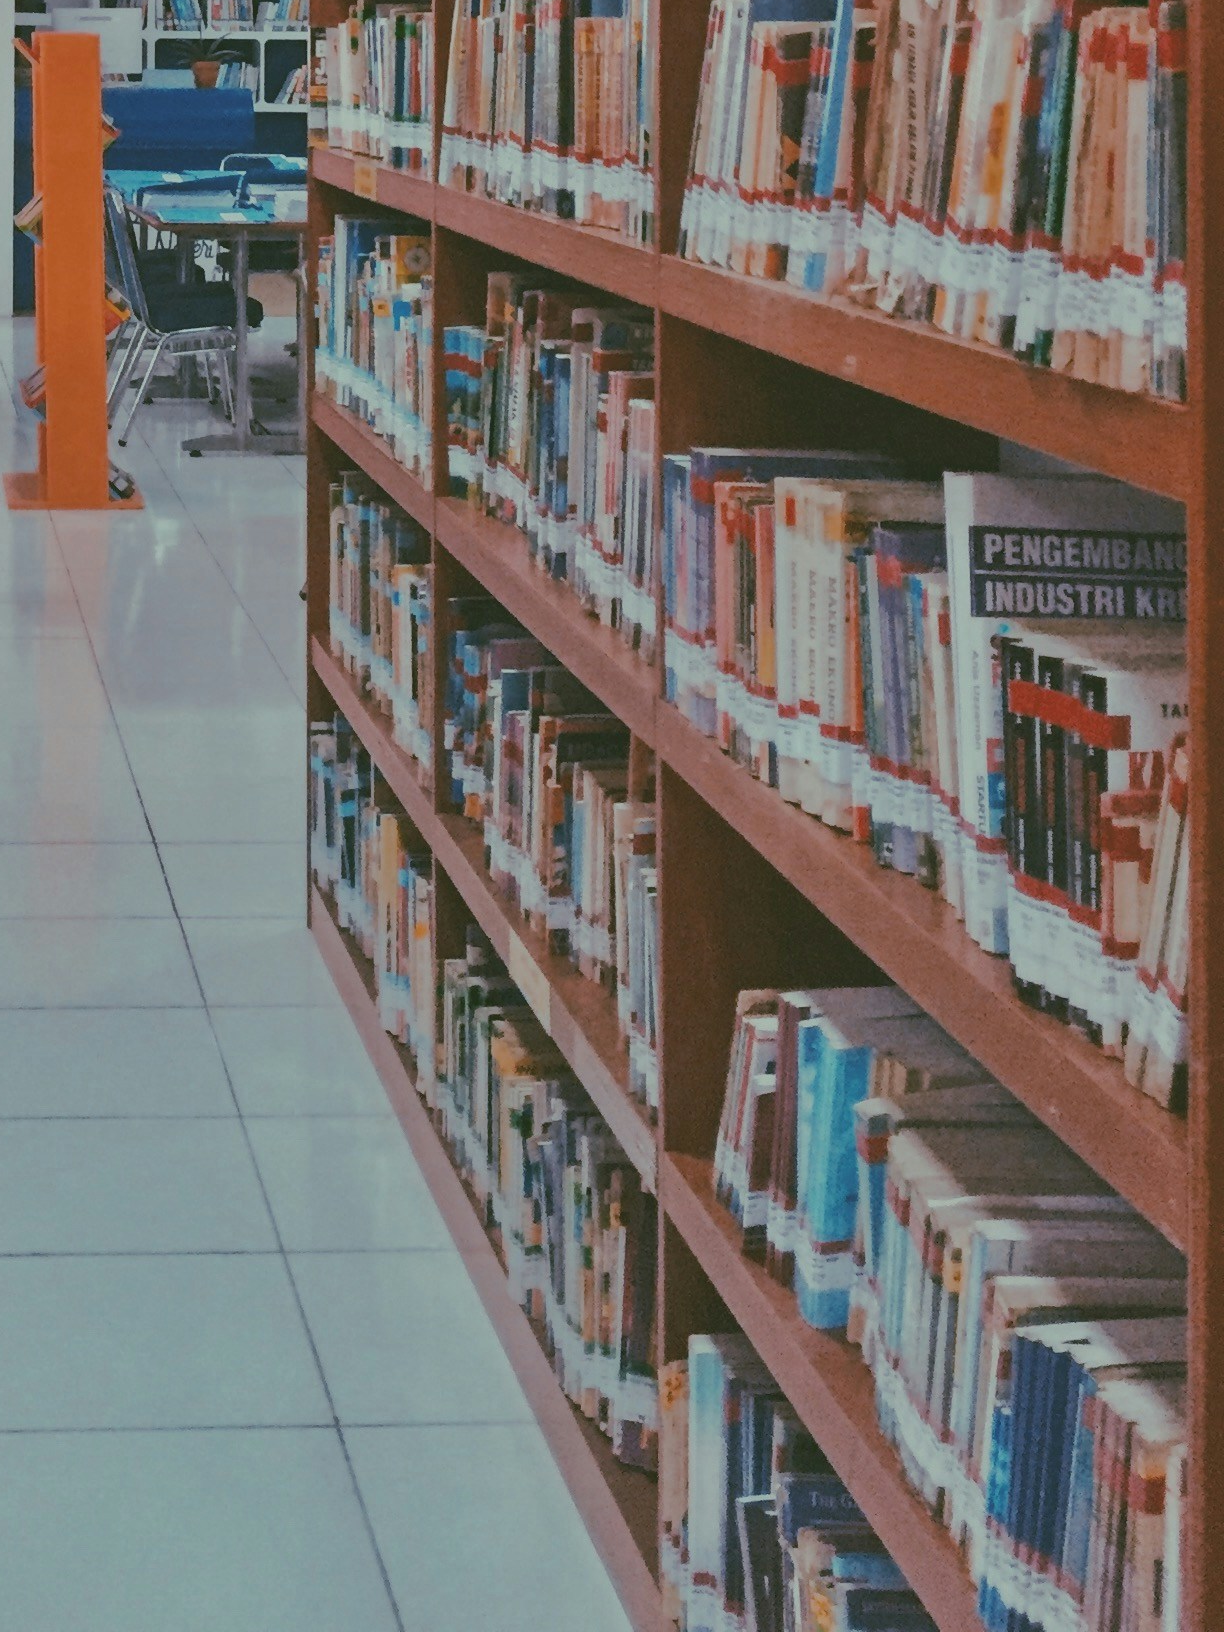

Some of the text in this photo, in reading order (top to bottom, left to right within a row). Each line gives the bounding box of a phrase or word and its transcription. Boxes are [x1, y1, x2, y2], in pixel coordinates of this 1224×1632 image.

[984, 580, 1125, 617] INDUSTRI
[827, 576, 837, 721] MAKRO EKONO
[976, 775, 986, 835] STARTU
